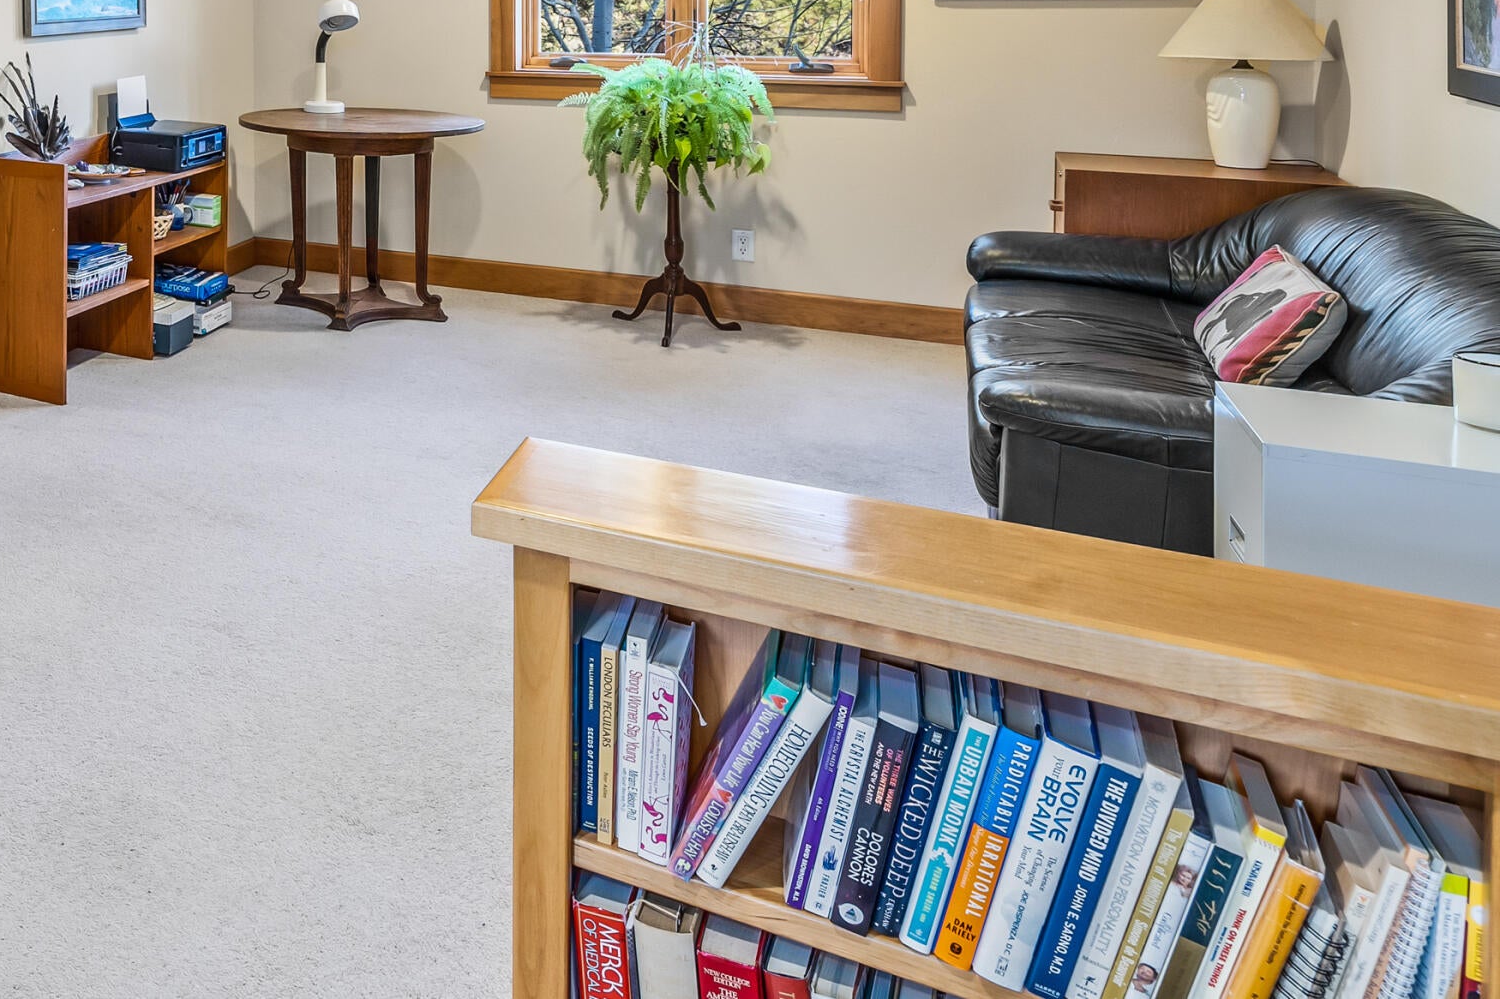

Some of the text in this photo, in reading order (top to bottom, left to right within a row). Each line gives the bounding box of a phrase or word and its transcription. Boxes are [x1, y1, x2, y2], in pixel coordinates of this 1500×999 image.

[602, 657, 612, 748] LONDON PECULIARS
[622, 669, 641, 763] Strong Women Stay Young
[833, 704, 848, 729] IODINE
[587, 749, 593, 758] OF
[722, 707, 778, 789] You Can Heal Your Life
[834, 730, 842, 742] WHY
[853, 729, 865, 742] THE
[920, 743, 944, 759] THE
[747, 722, 812, 810] HOMECOMING
[841, 742, 864, 785] CRYSTAL
[864, 742, 885, 804] AND THE NEW EARTH
[873, 748, 893, 805] OF VOLUNTEERS
[882, 748, 904, 812] THE THREE WAVES
[988, 765, 1003, 789] Hidden
[894, 754, 941, 844] WICKED
[937, 735, 982, 848] THE URBAN MONK
[990, 740, 1032, 834] PREDICTABLY
[1025, 755, 1066, 842] your BRAIN
[1047, 763, 1087, 843] EVOLVE
[695, 799, 725, 836] LOUISE
[812, 804, 821, 821] Edition
[827, 786, 854, 843] ALCHEMIST
[1076, 776, 1128, 883] THE DIVIDED MIND
[681, 837, 703, 861] HAY
[711, 800, 759, 864] JOHN BRADSHAW
[802, 843, 812, 858] DAVID
[970, 825, 985, 846] Shape
[1165, 827, 1182, 844] The
[846, 826, 870, 881] CANNON
[858, 831, 884, 886] DOLORES
[882, 842, 917, 899] DEEP
[967, 846, 978, 861] Our
[1013, 844, 1032, 879] Your Mind
[1023, 848, 1045, 888] of Changing
[1153, 864, 1167, 876] of
[1156, 842, 1176, 866] Ethics
[958, 859, 975, 889] Decisions
[964, 834, 1004, 919] IRRATIONAL
[1038, 855, 1057, 892] The Science
[1093, 795, 1161, 956] MOTIVATION AND PERSONALITY
[880, 897, 895, 929] ERNSHAW
[1019, 888, 1030, 903] JOE
[943, 922, 977, 942] ARIELY
[952, 917, 973, 931] DAN
[1007, 904, 1025, 941] DISPENZA
[1047, 883, 1089, 976] JOHN E. SARNO, M.D.
[1226, 929, 1237, 942] ON
[1231, 908, 1246, 929] THINK
[583, 918, 602, 993] OF MEDICAL
[598, 922, 624, 997] MERCK
[1111, 918, 1147, 988] Simone de Beauvoir
[1218, 942, 1232, 962] THESE
[703, 967, 751, 987] NEW COLLEGE
[713, 976, 741, 989] EDITION
[718, 986, 738, 999] THE
[1207, 962, 1224, 988] THINGS
